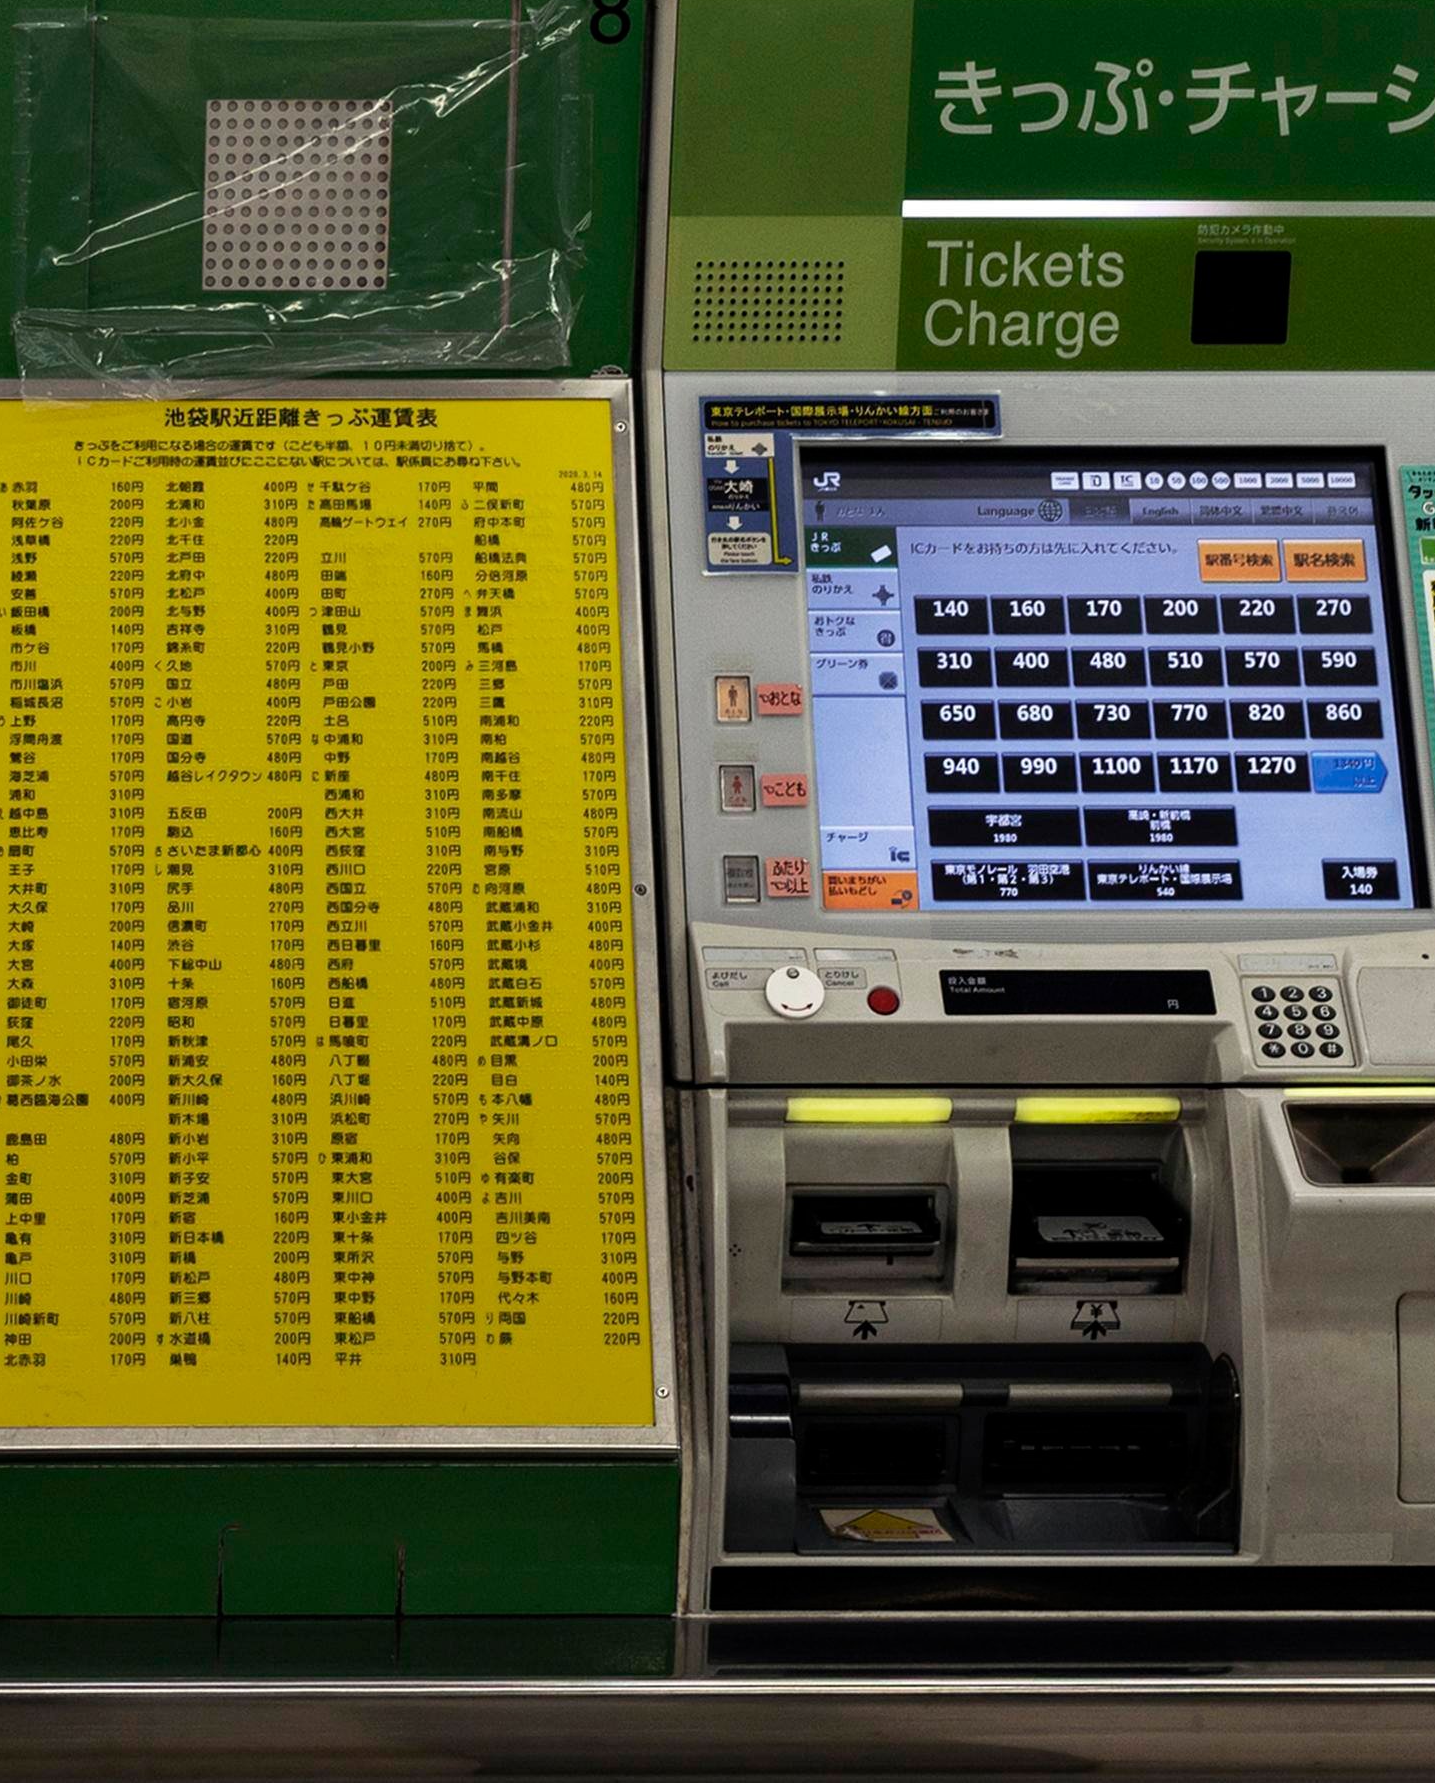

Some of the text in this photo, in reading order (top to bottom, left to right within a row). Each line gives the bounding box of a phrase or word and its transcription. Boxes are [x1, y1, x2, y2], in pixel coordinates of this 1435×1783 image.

[927, 240, 1124, 288] Tickets
[924, 298, 1120, 359] Charge
[165, 407, 438, 428] 池袋駅近距離きっぷ運賃表
[724, 479, 754, 494] 大崎
[933, 600, 969, 617] 140
[1010, 600, 1046, 617] 160
[1086, 599, 1122, 617] 170
[1163, 599, 1199, 616] 200
[1092, 757, 1141, 775] 1100
[1247, 756, 1296, 774] 1270
